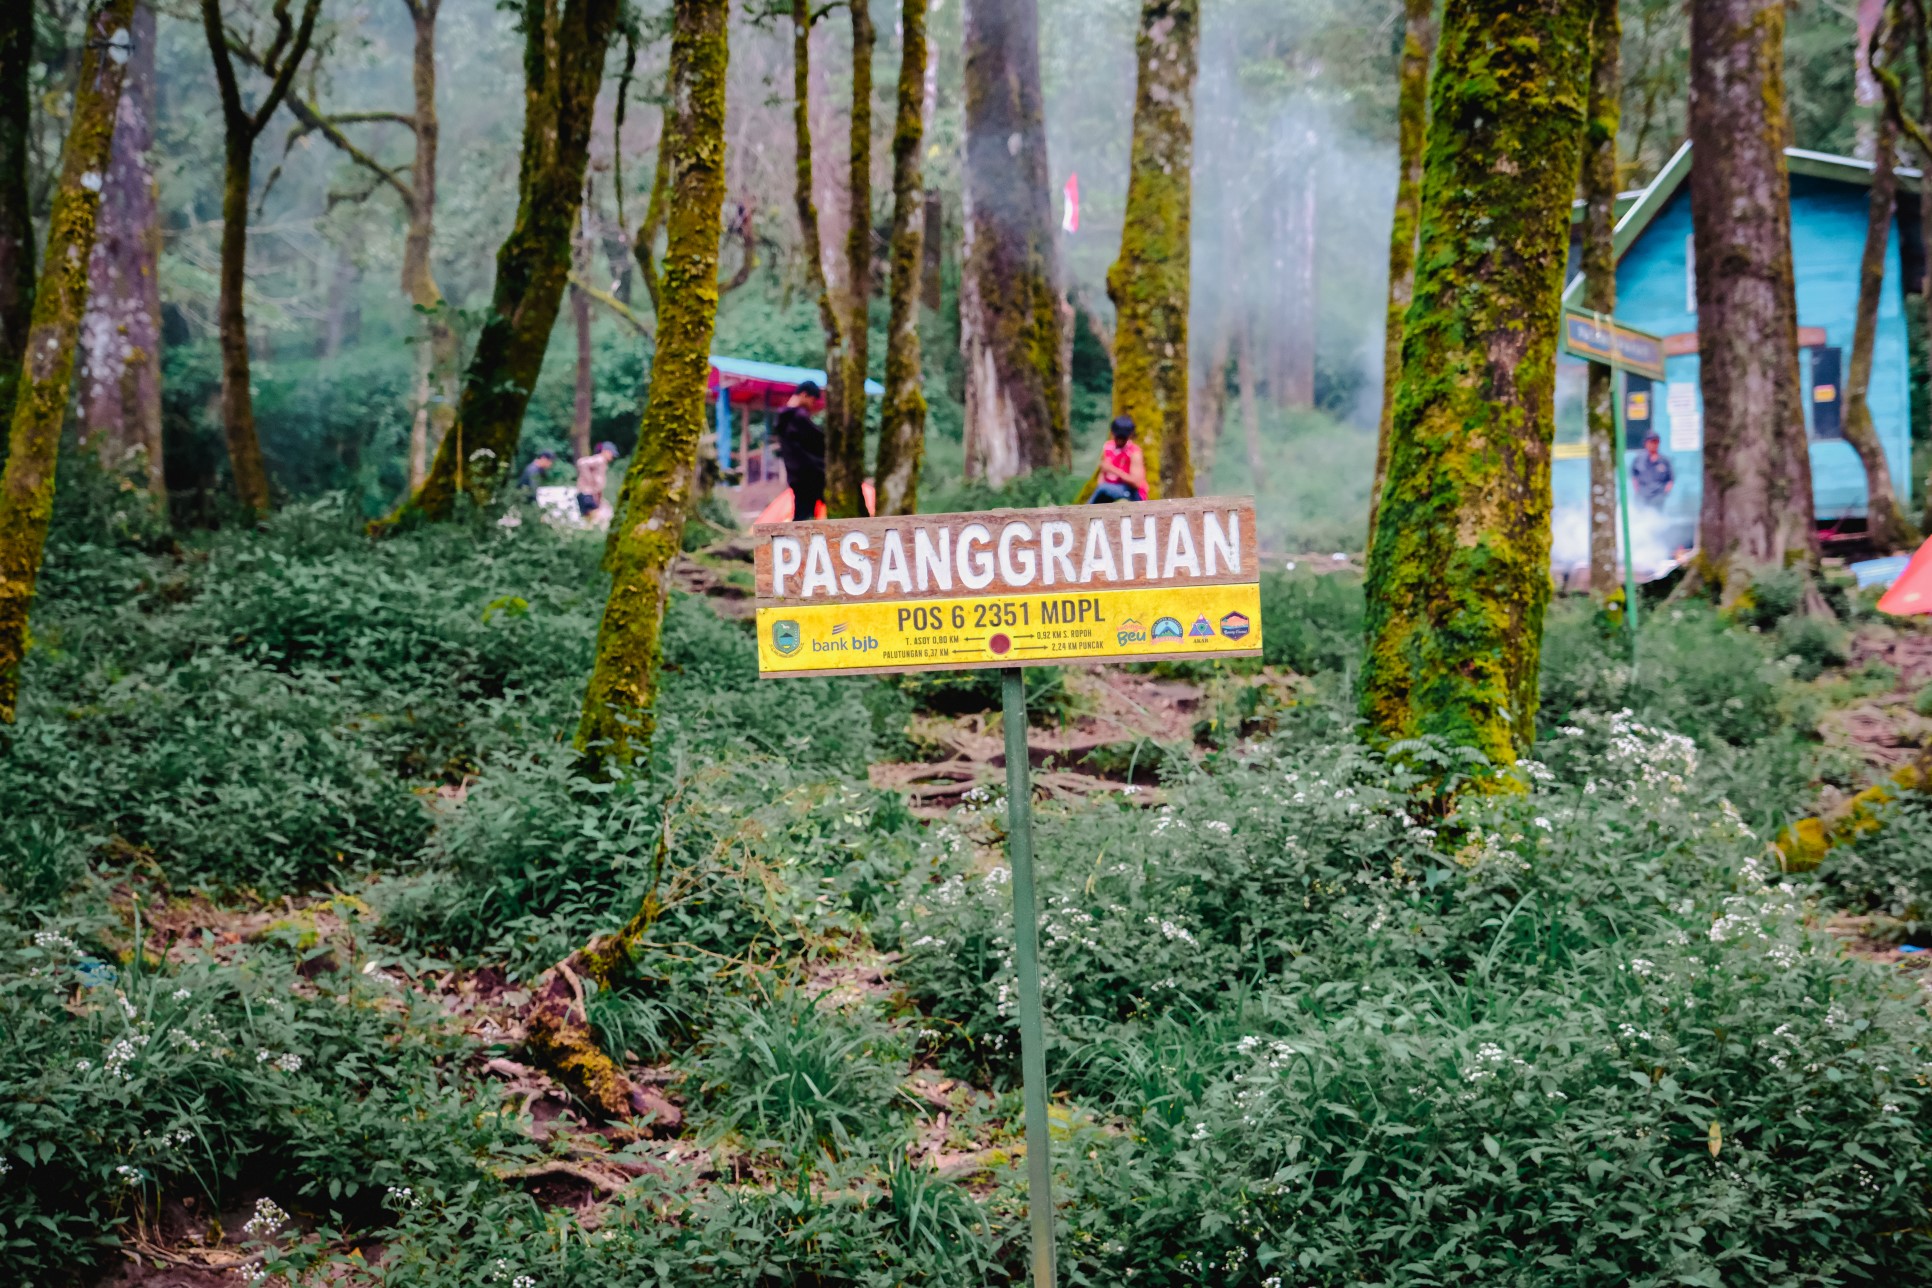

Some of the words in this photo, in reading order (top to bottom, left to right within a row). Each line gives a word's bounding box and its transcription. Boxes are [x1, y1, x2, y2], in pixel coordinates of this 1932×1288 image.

[773, 510, 1241, 597] PASANGGRAHAN
[898, 606, 943, 631] POS
[952, 605, 965, 629] 6
[974, 601, 1030, 628] 2351
[1041, 598, 1105, 625] MDPL
[914, 636, 930, 645] ASOY
[949, 635, 959, 643] KM
[1052, 630, 1062, 639] KM
[1071, 629, 1092, 638] ROPOH
[1117, 631, 1146, 646] Beu
[812, 637, 848, 652] bank
[852, 635, 879, 652] bjb
[1068, 642, 1077, 650] KM
[1078, 641, 1104, 650] PUNCAK
[883, 649, 923, 659] PALUTUNGAN
[940, 647, 949, 656] KM
